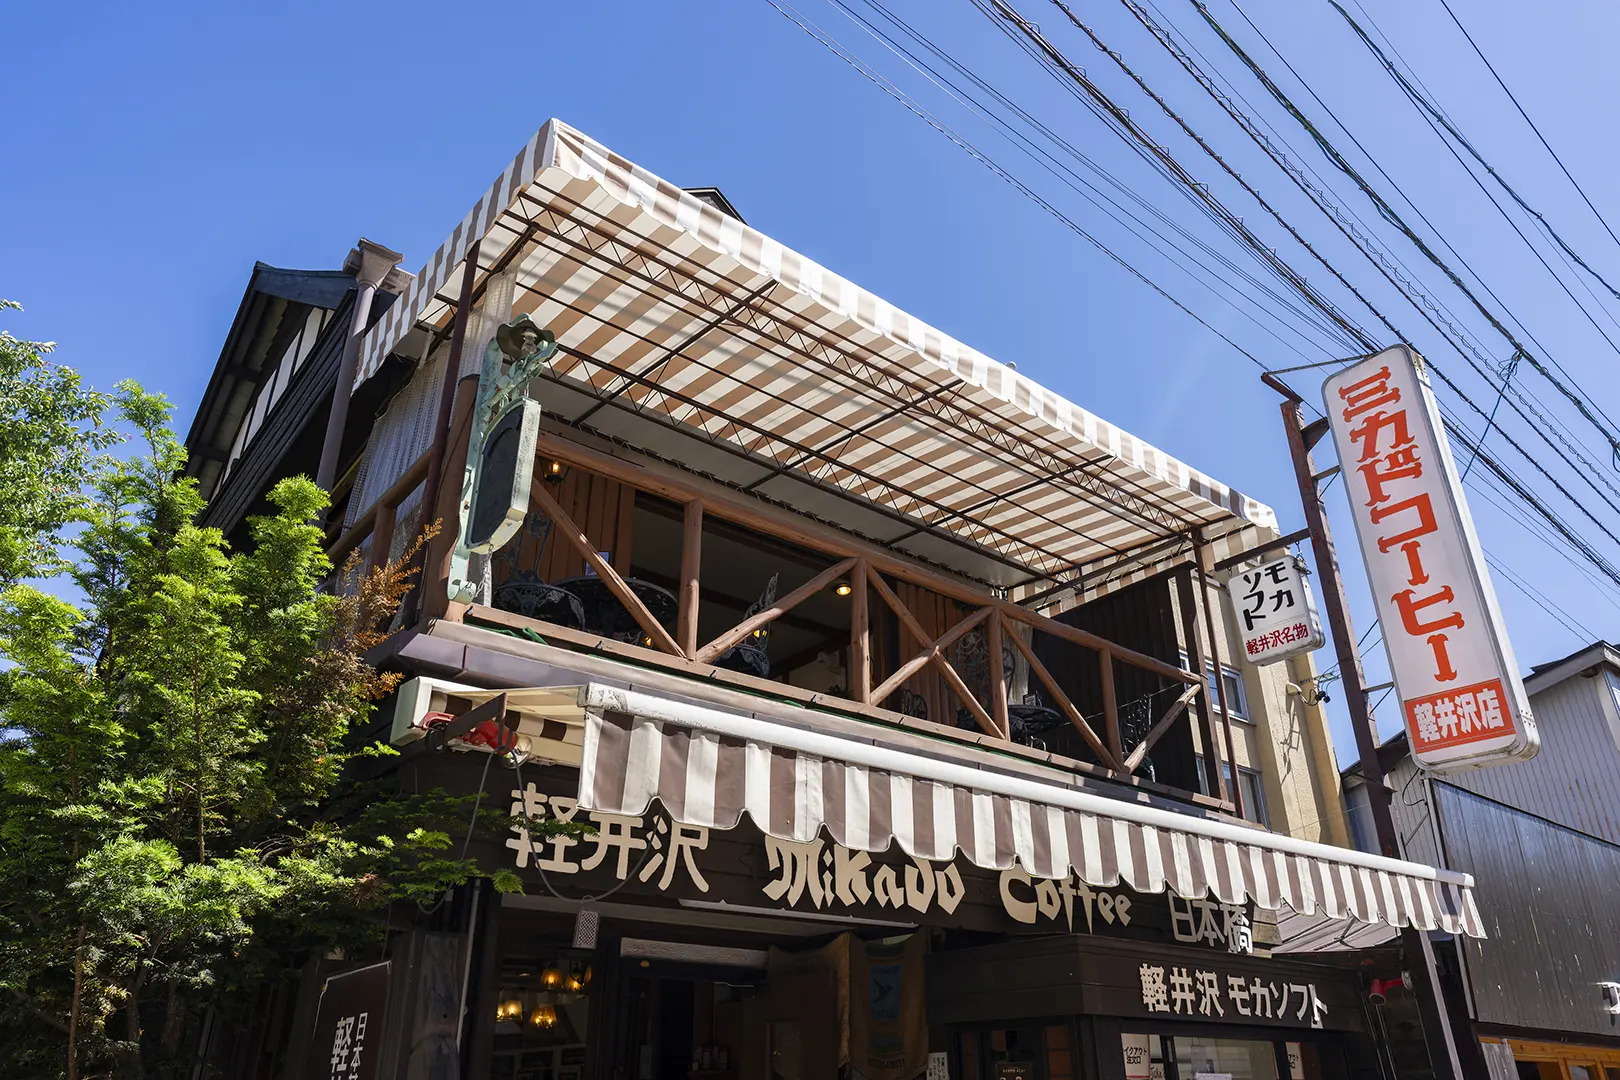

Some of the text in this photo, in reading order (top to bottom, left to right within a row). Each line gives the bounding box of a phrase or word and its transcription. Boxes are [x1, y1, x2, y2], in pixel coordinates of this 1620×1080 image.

[1338, 365, 1465, 683] ミカドコーヒー
[1246, 622, 1309, 656] 軽井沢名物
[1413, 687, 1505, 743] 軽井沢店
[505, 781, 710, 893] 軽井沢
[999, 865, 1133, 935] Coffee
[1168, 889, 1253, 954] 日本橋
[1139, 962, 1328, 1022] 軽井沢 モカソフト
[330, 1016, 355, 1080] 軽
